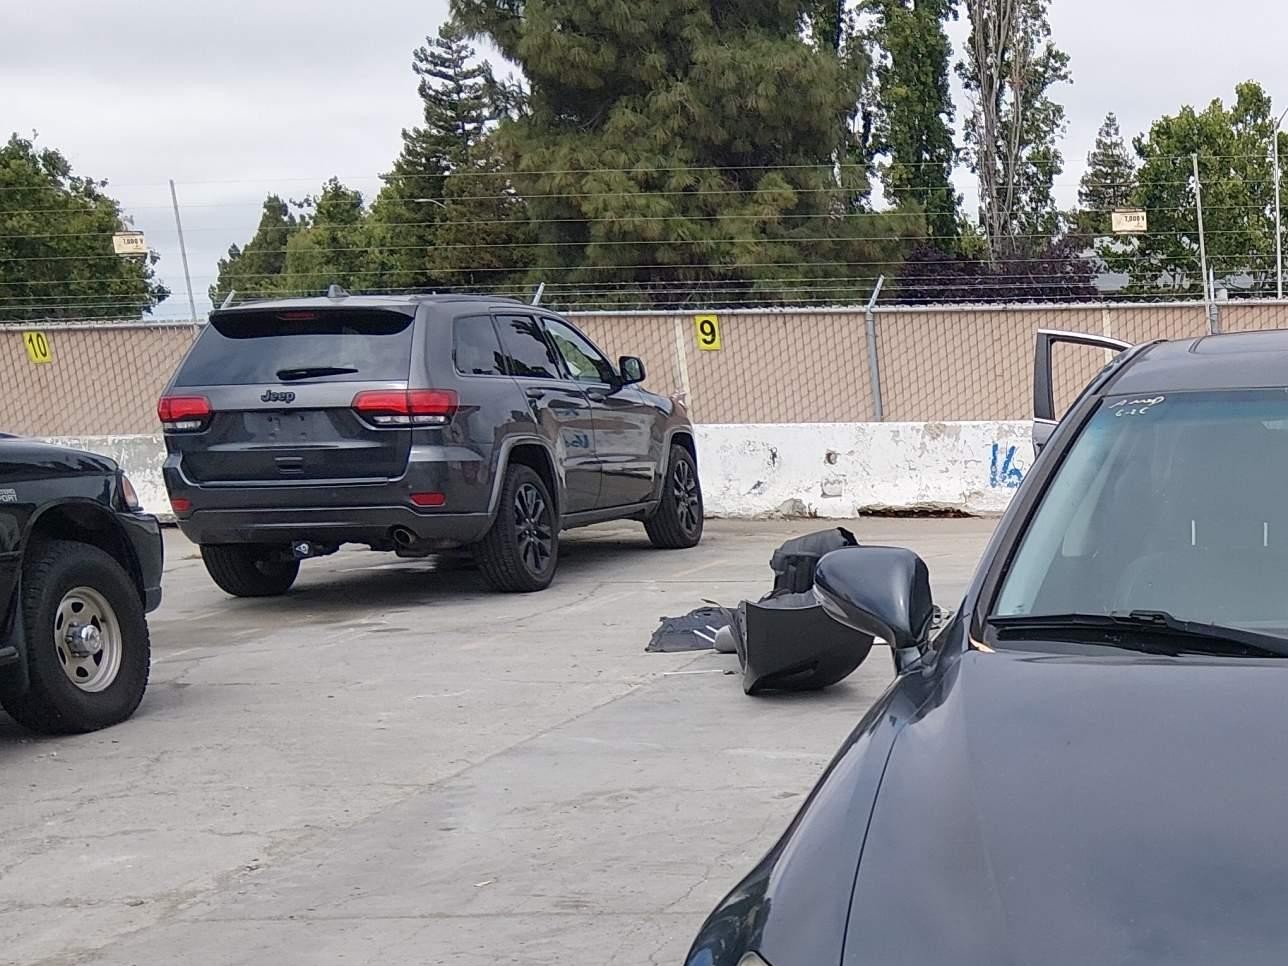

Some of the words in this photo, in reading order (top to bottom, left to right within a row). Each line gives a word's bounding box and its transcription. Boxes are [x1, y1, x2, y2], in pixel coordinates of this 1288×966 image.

[700, 319, 716, 345] 9
[28, 333, 47, 358] 10
[261, 390, 296, 404] Jeep
